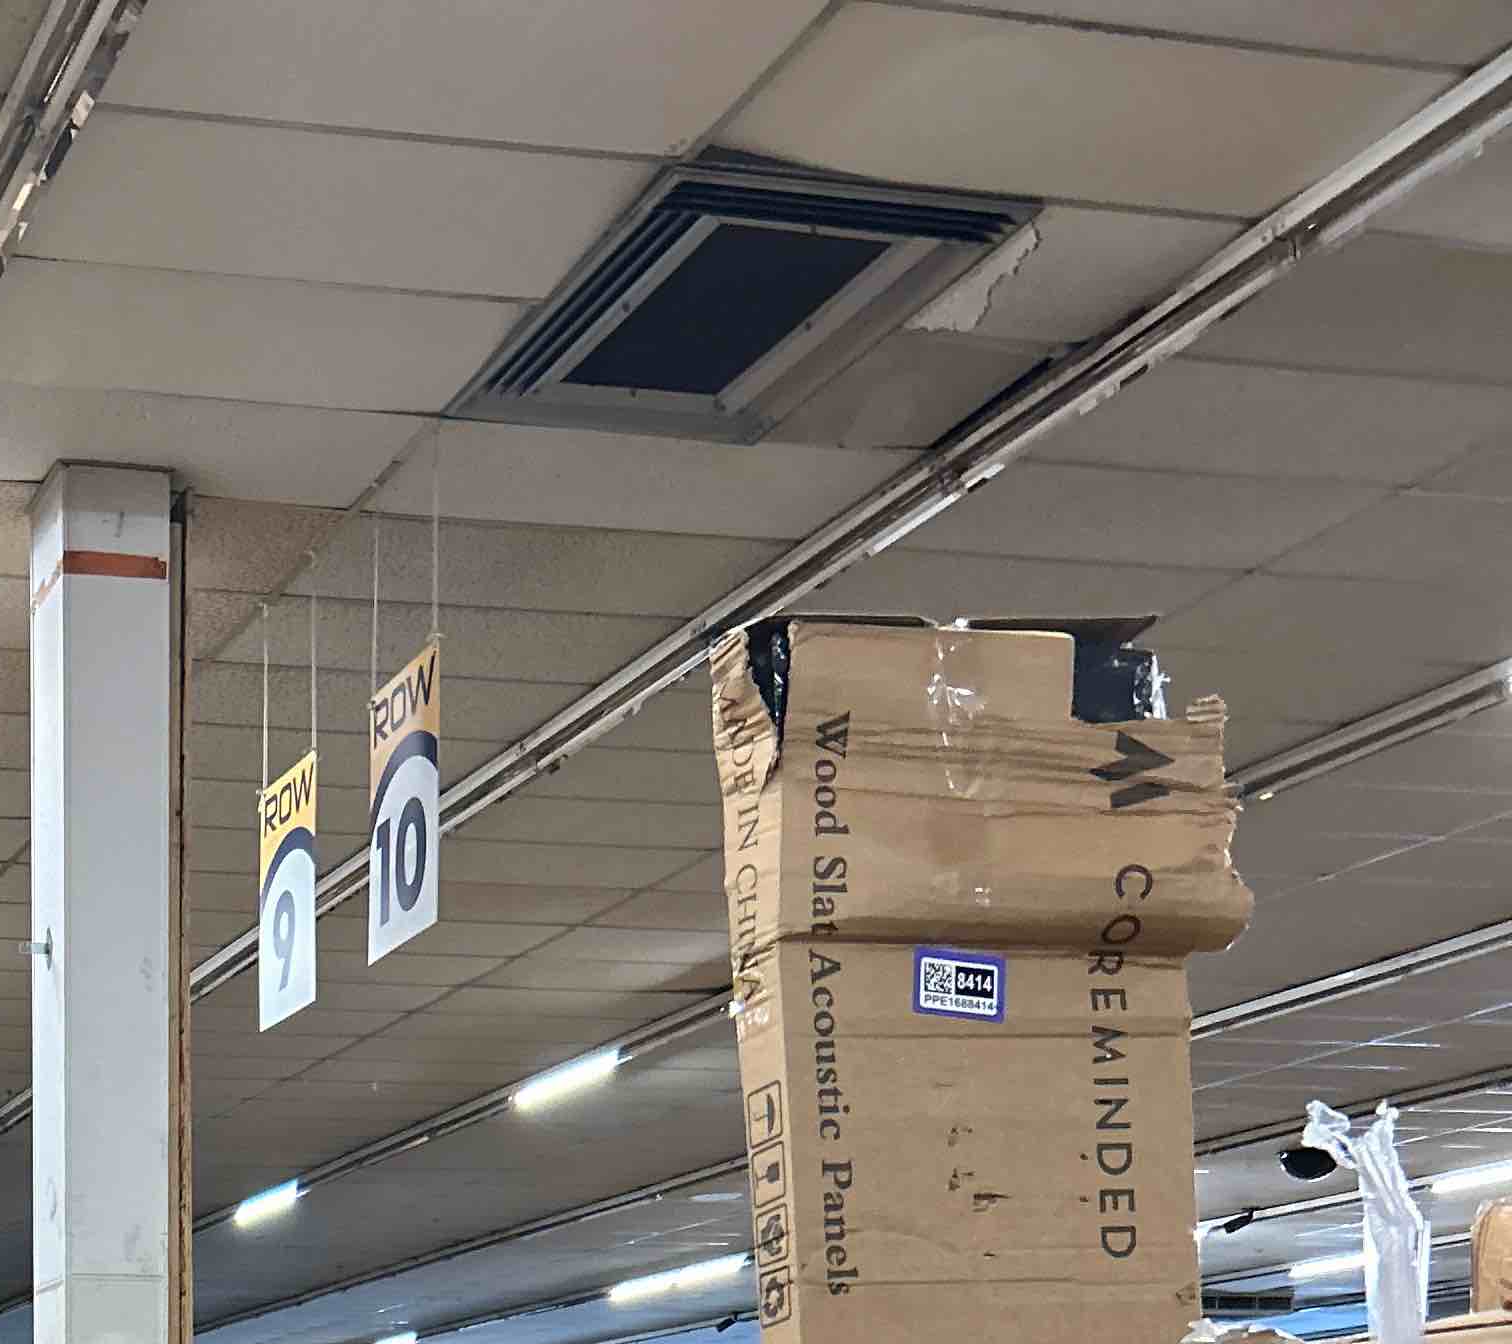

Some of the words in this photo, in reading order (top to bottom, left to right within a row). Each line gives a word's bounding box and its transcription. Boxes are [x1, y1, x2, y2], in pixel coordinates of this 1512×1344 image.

[373, 651, 436, 746] ROW
[264, 763, 314, 837] ROW
[814, 710, 851, 836] Wood
[376, 798, 426, 928] 10
[737, 804, 759, 851] IN
[273, 890, 295, 992] 9
[812, 856, 848, 936] Slat
[923, 994, 995, 1010] PPE1688414
[957, 972, 993, 992] 8414
[809, 949, 850, 1141] Acoustic
[1088, 863, 1153, 1259] COREMINDED
[821, 1160, 859, 1297] Panels
